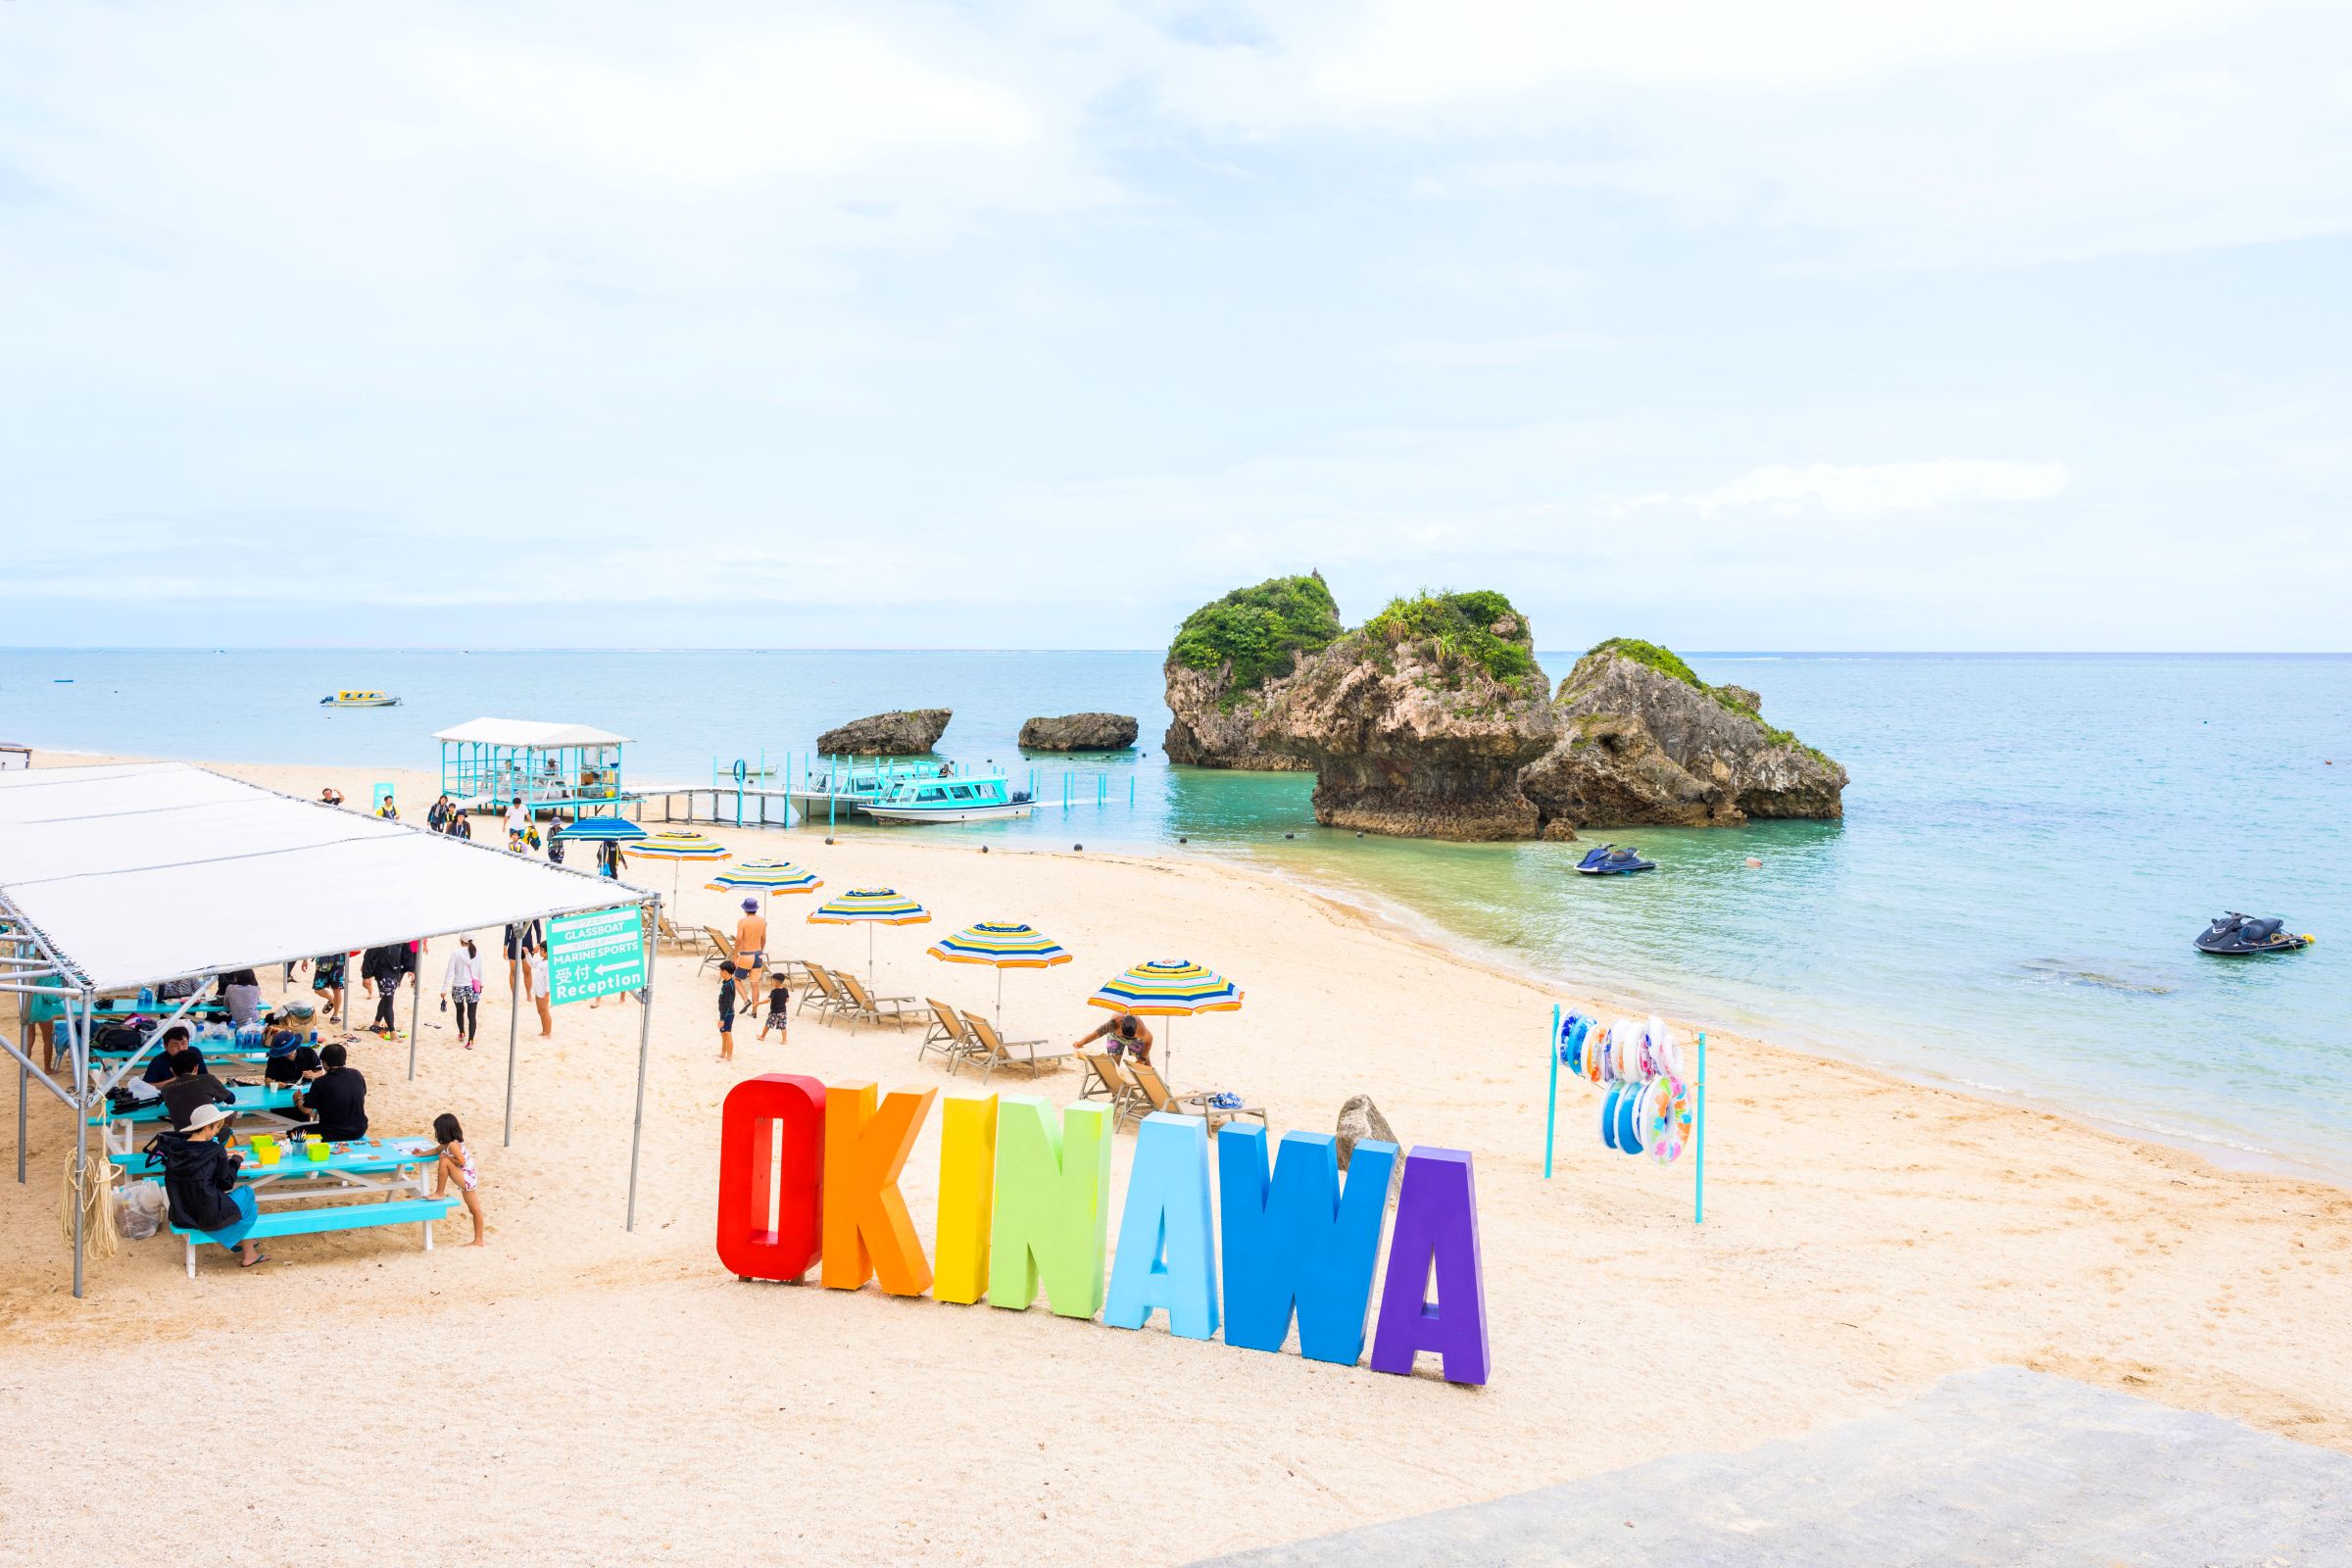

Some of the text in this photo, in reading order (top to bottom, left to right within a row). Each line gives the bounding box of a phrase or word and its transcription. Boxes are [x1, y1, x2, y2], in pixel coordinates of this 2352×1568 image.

[564, 922, 624, 941] GLASSBOAT
[556, 964, 590, 986] 受付
[557, 972, 641, 1000] Reception
[716, 1073, 1491, 1386] OKINAWA
